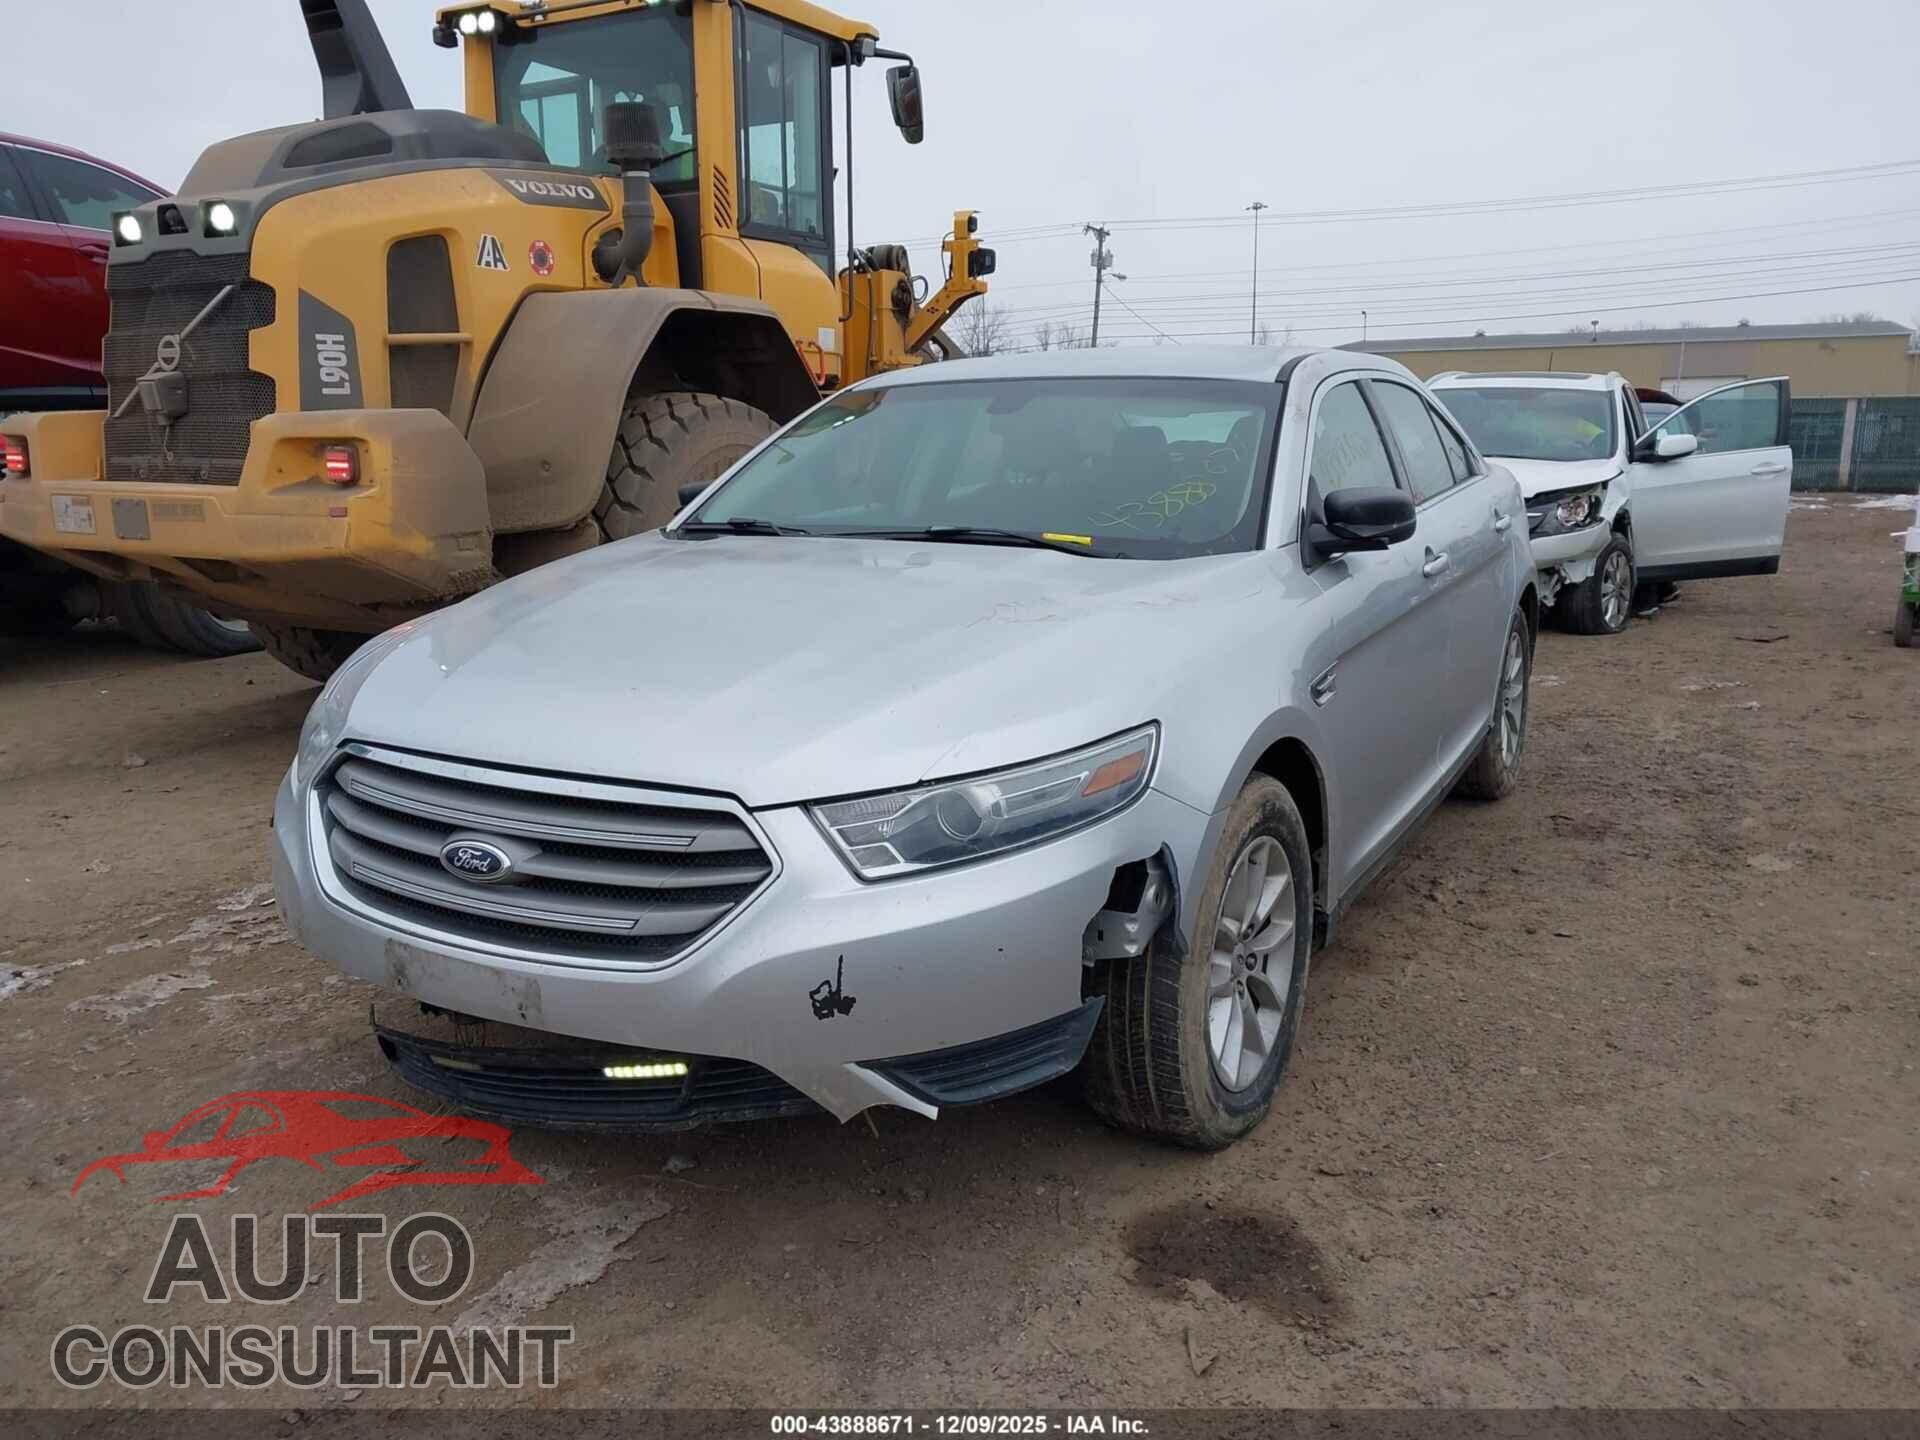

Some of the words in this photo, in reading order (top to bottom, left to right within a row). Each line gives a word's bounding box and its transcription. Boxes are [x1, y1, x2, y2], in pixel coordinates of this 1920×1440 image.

[504, 178, 595, 200] VOLVO
[314, 333, 351, 395] L90H
[453, 847, 492, 872] Ford
